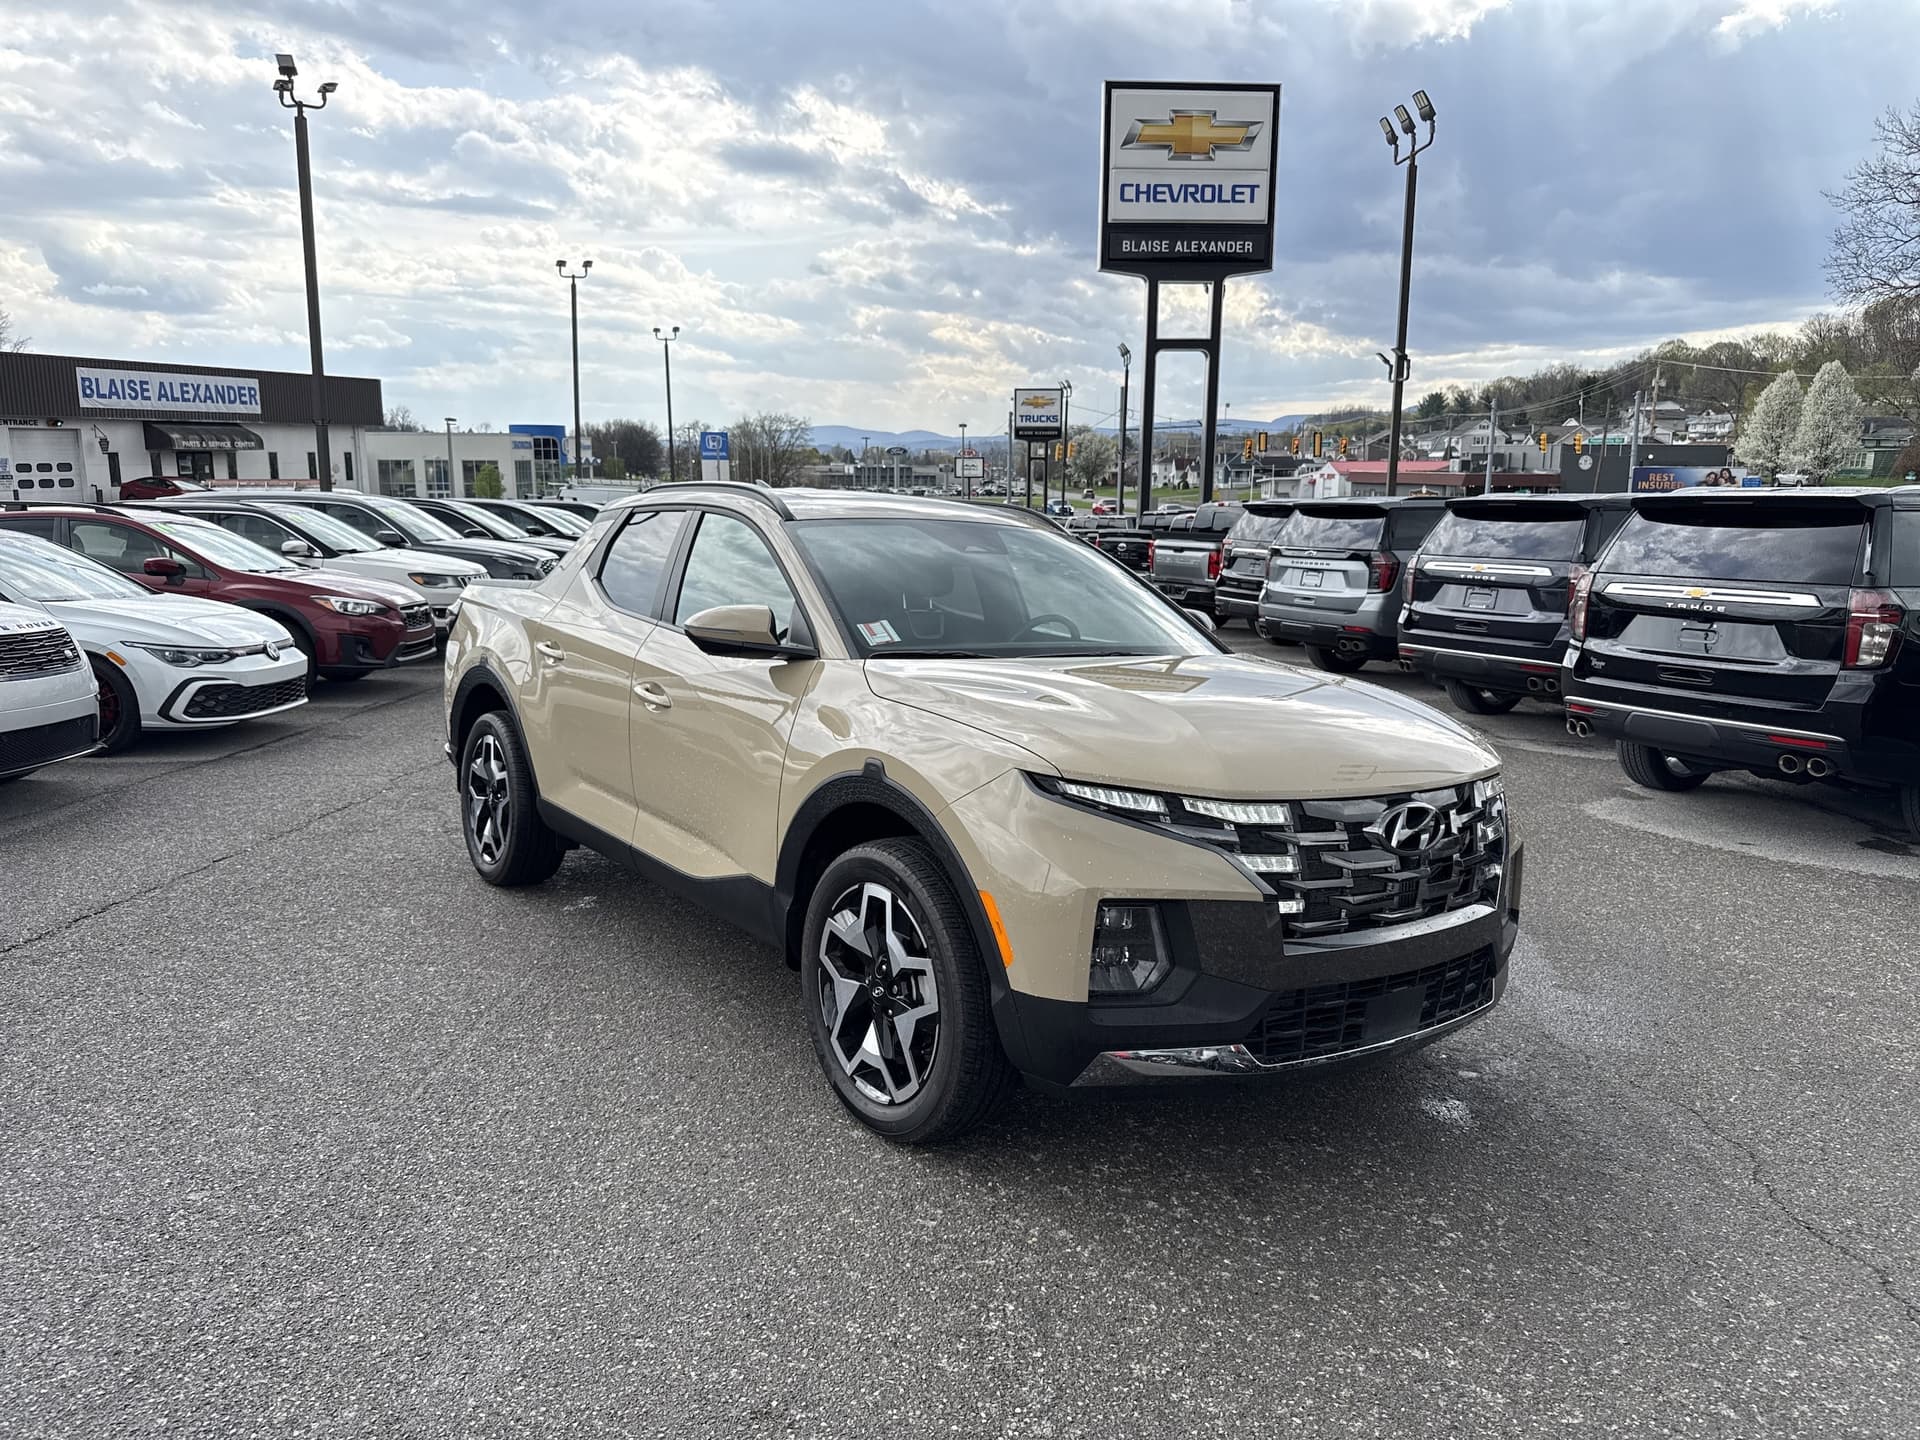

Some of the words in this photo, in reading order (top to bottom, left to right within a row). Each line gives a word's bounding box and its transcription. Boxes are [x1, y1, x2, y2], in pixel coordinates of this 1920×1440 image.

[1119, 183, 1261, 204] CHEVROLET
[1121, 239, 1170, 253] BLAISE
[1174, 240, 1253, 254] ALEXANDER
[80, 376, 152, 401] BLAISE
[157, 380, 260, 406] ALEXANDER
[0, 418, 39, 426] ENTRANCE
[1019, 414, 1059, 423] TRUCKS
[1649, 473, 1676, 482] REST
[1637, 480, 1686, 490] INSURED
[1666, 602, 1727, 613] TAHOE
